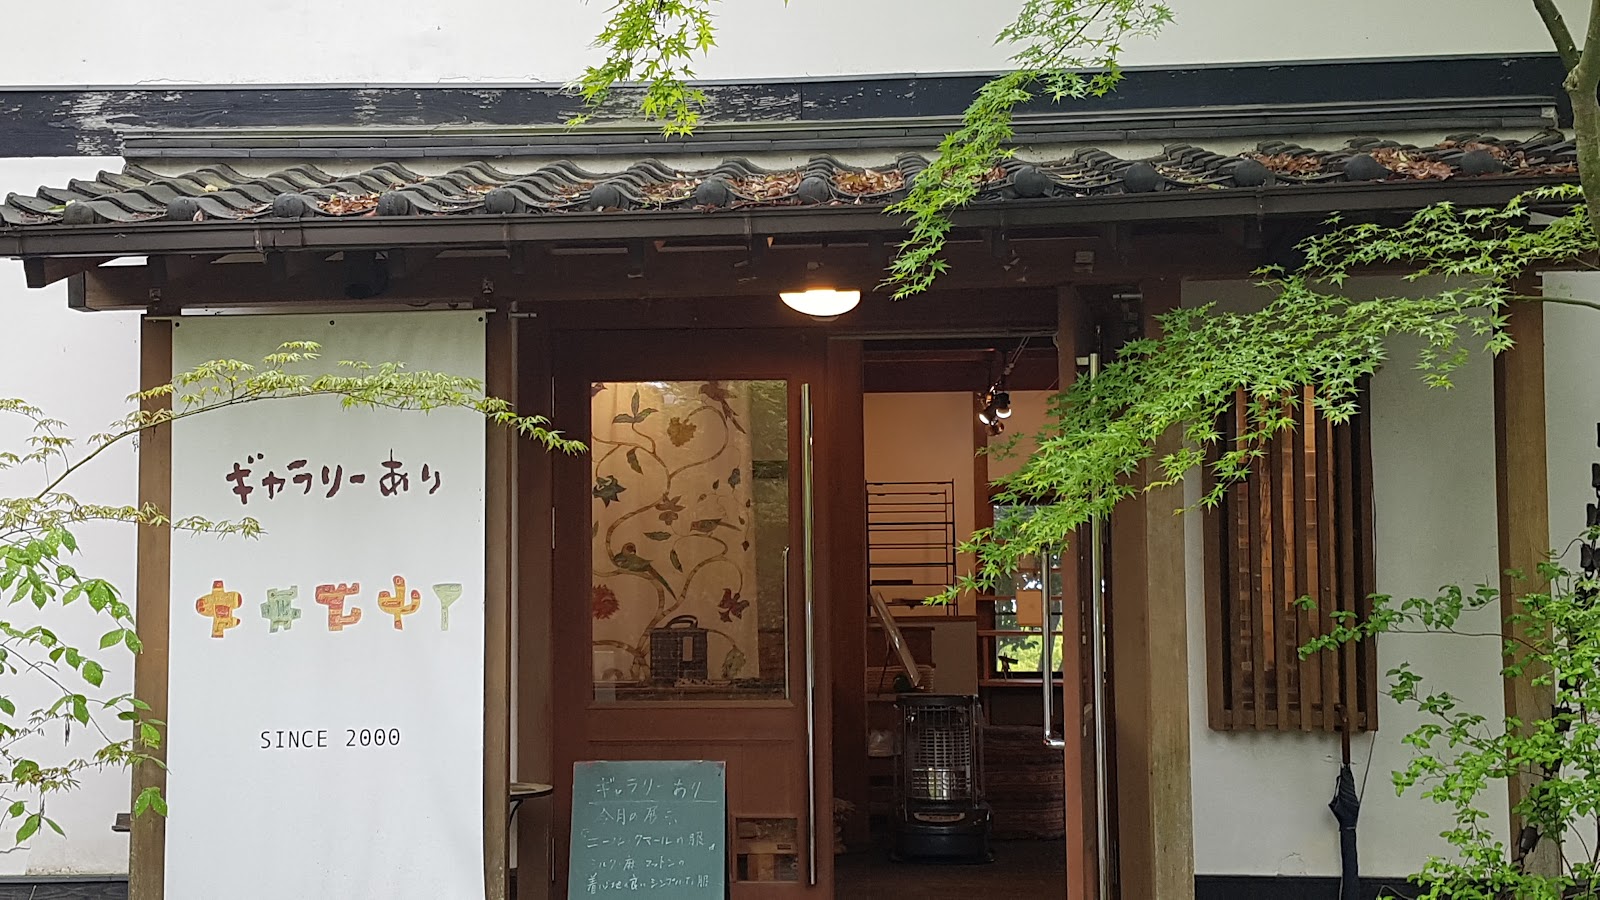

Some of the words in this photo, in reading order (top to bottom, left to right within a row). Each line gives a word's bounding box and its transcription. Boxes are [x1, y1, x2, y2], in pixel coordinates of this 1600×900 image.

[225, 448, 442, 505] ギャラリーあり
[260, 729, 328, 749] SINCE
[345, 727, 401, 748] 2000
[598, 806, 678, 826] 今月の展示
